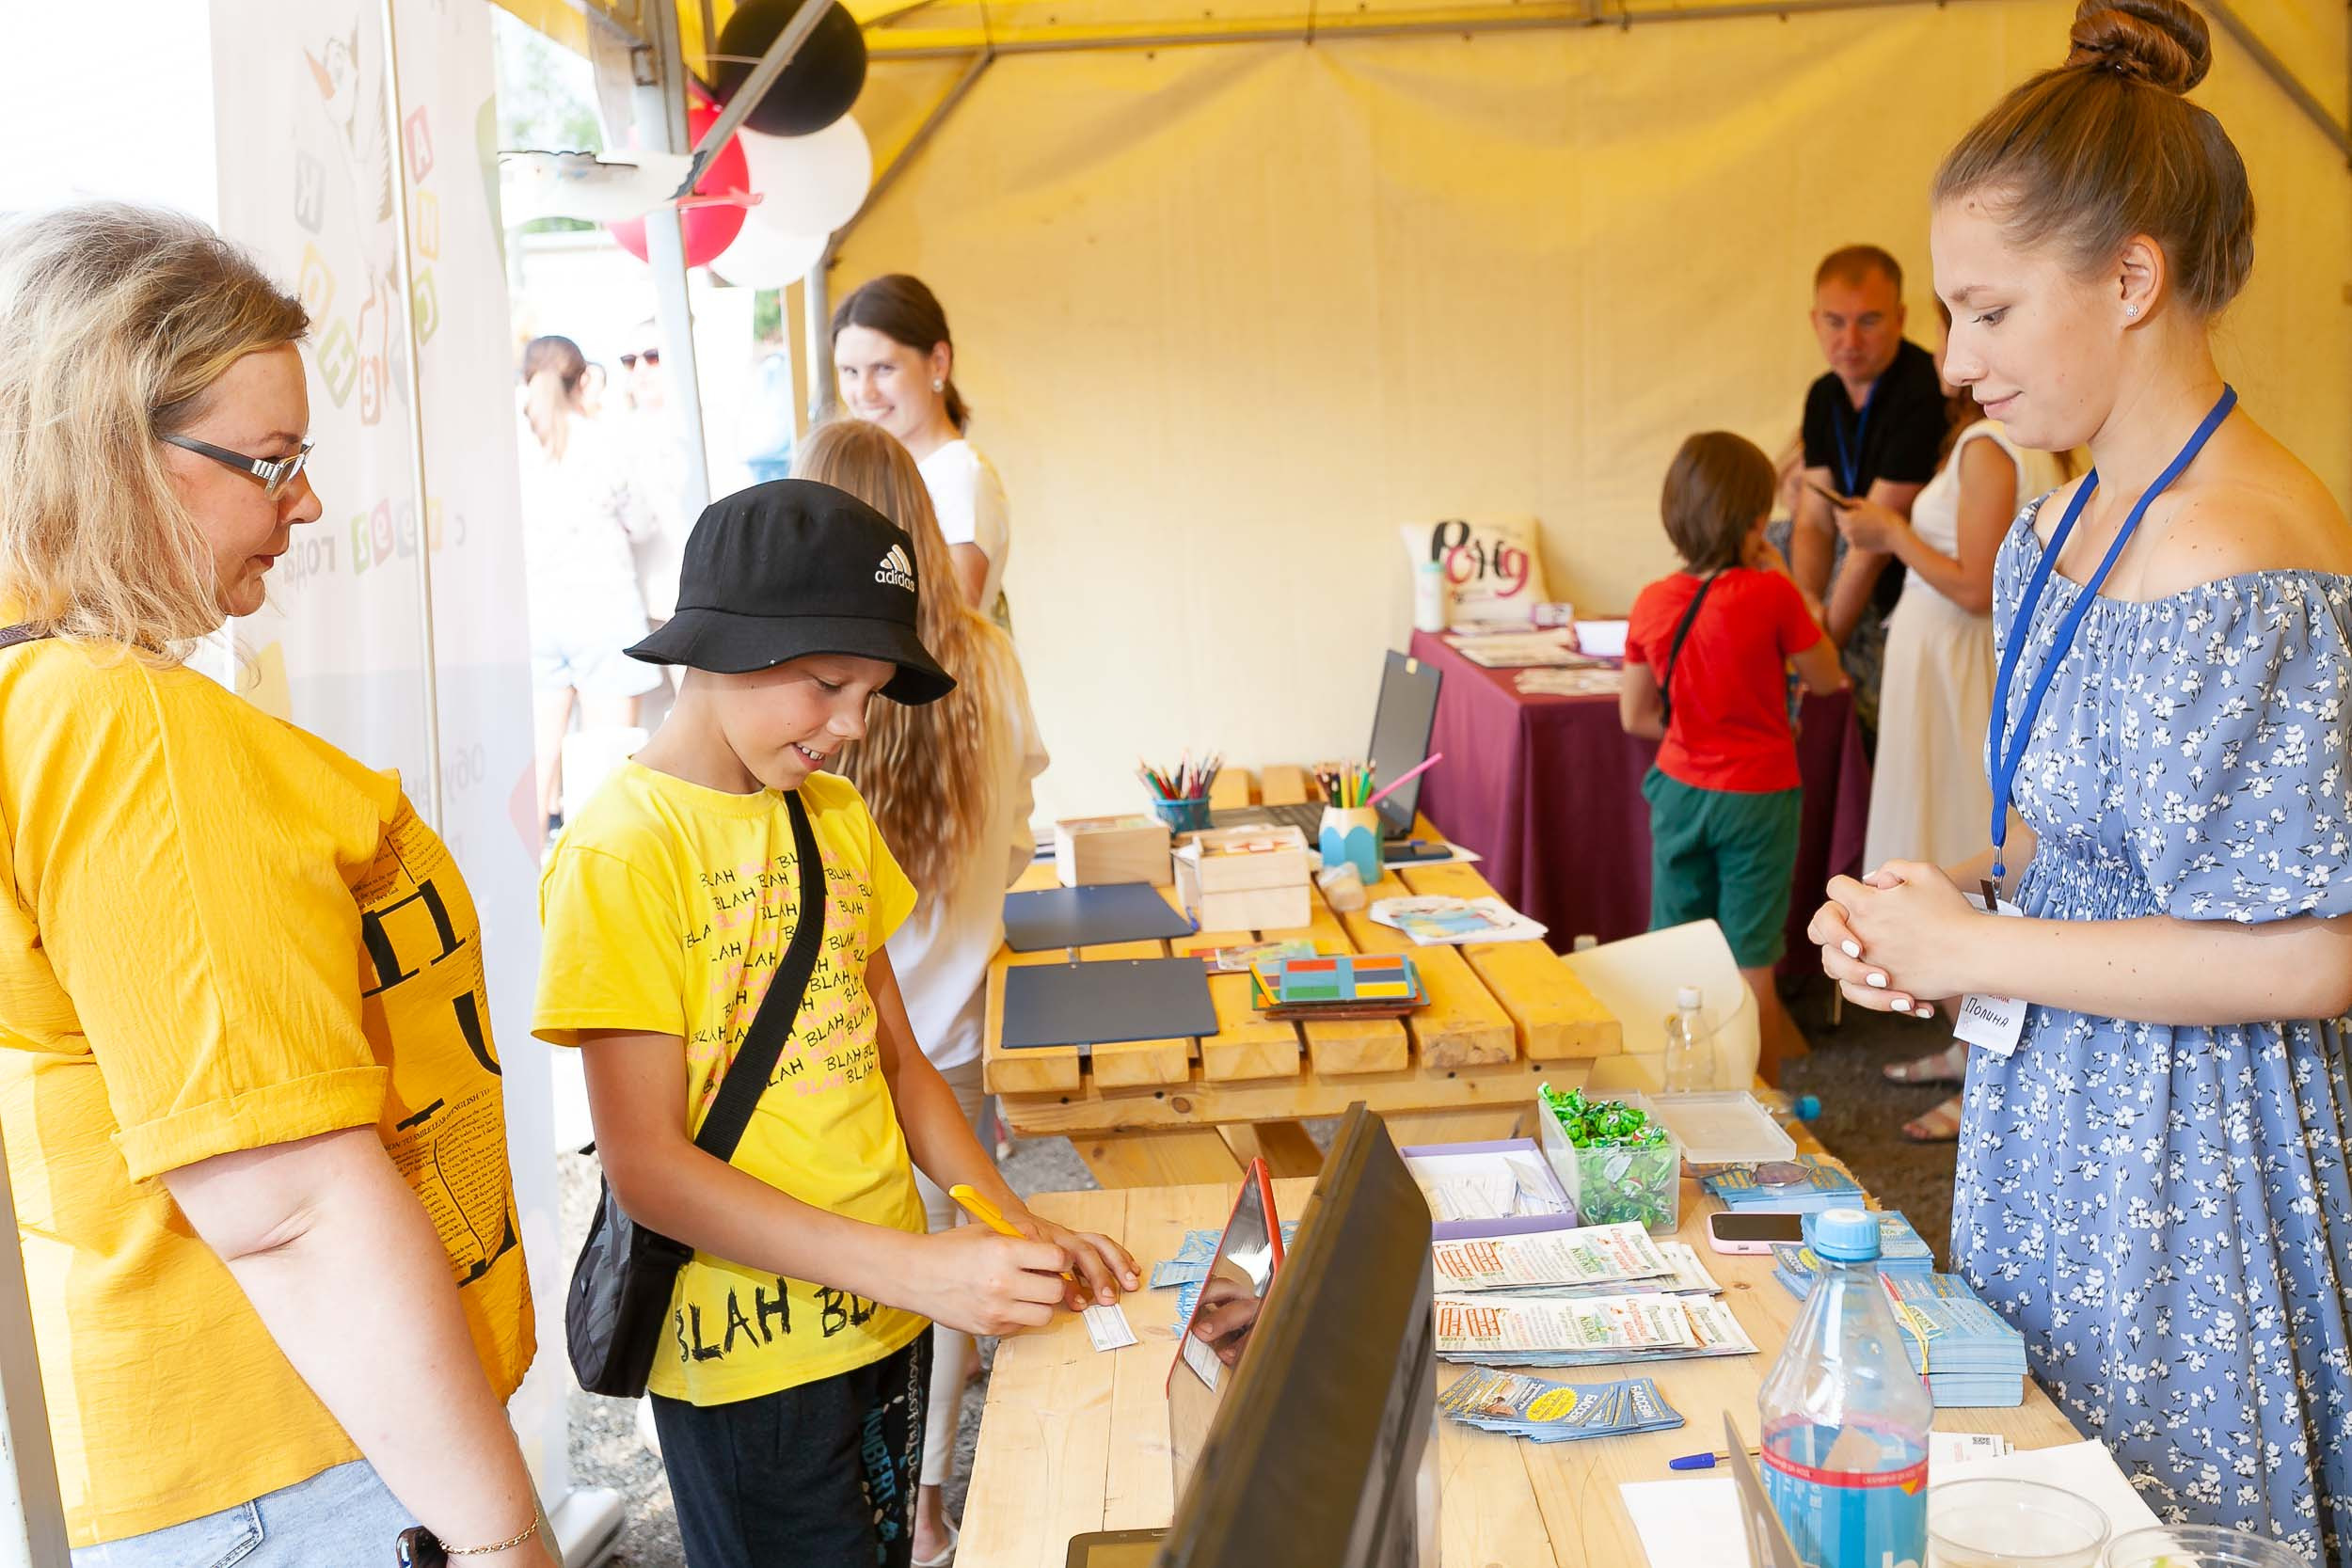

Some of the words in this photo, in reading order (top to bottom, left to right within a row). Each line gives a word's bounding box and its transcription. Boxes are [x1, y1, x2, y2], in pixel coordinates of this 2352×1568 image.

[875, 570, 914, 593] adidas
[712, 887, 756, 911] BLAH
[809, 971, 850, 992] BLAH
[802, 1012, 845, 1047] BLAH
[845, 1005, 872, 1035] BLAH
[1964, 997, 2010, 1028] Полина
[767, 1057, 804, 1087] LAH
[823, 1048, 861, 1070] BLAH
[846, 1060, 873, 1084] BLAH
[675, 1275, 791, 1363] BLAH
[1630, 1384, 1657, 1419] БАССЕЙН
